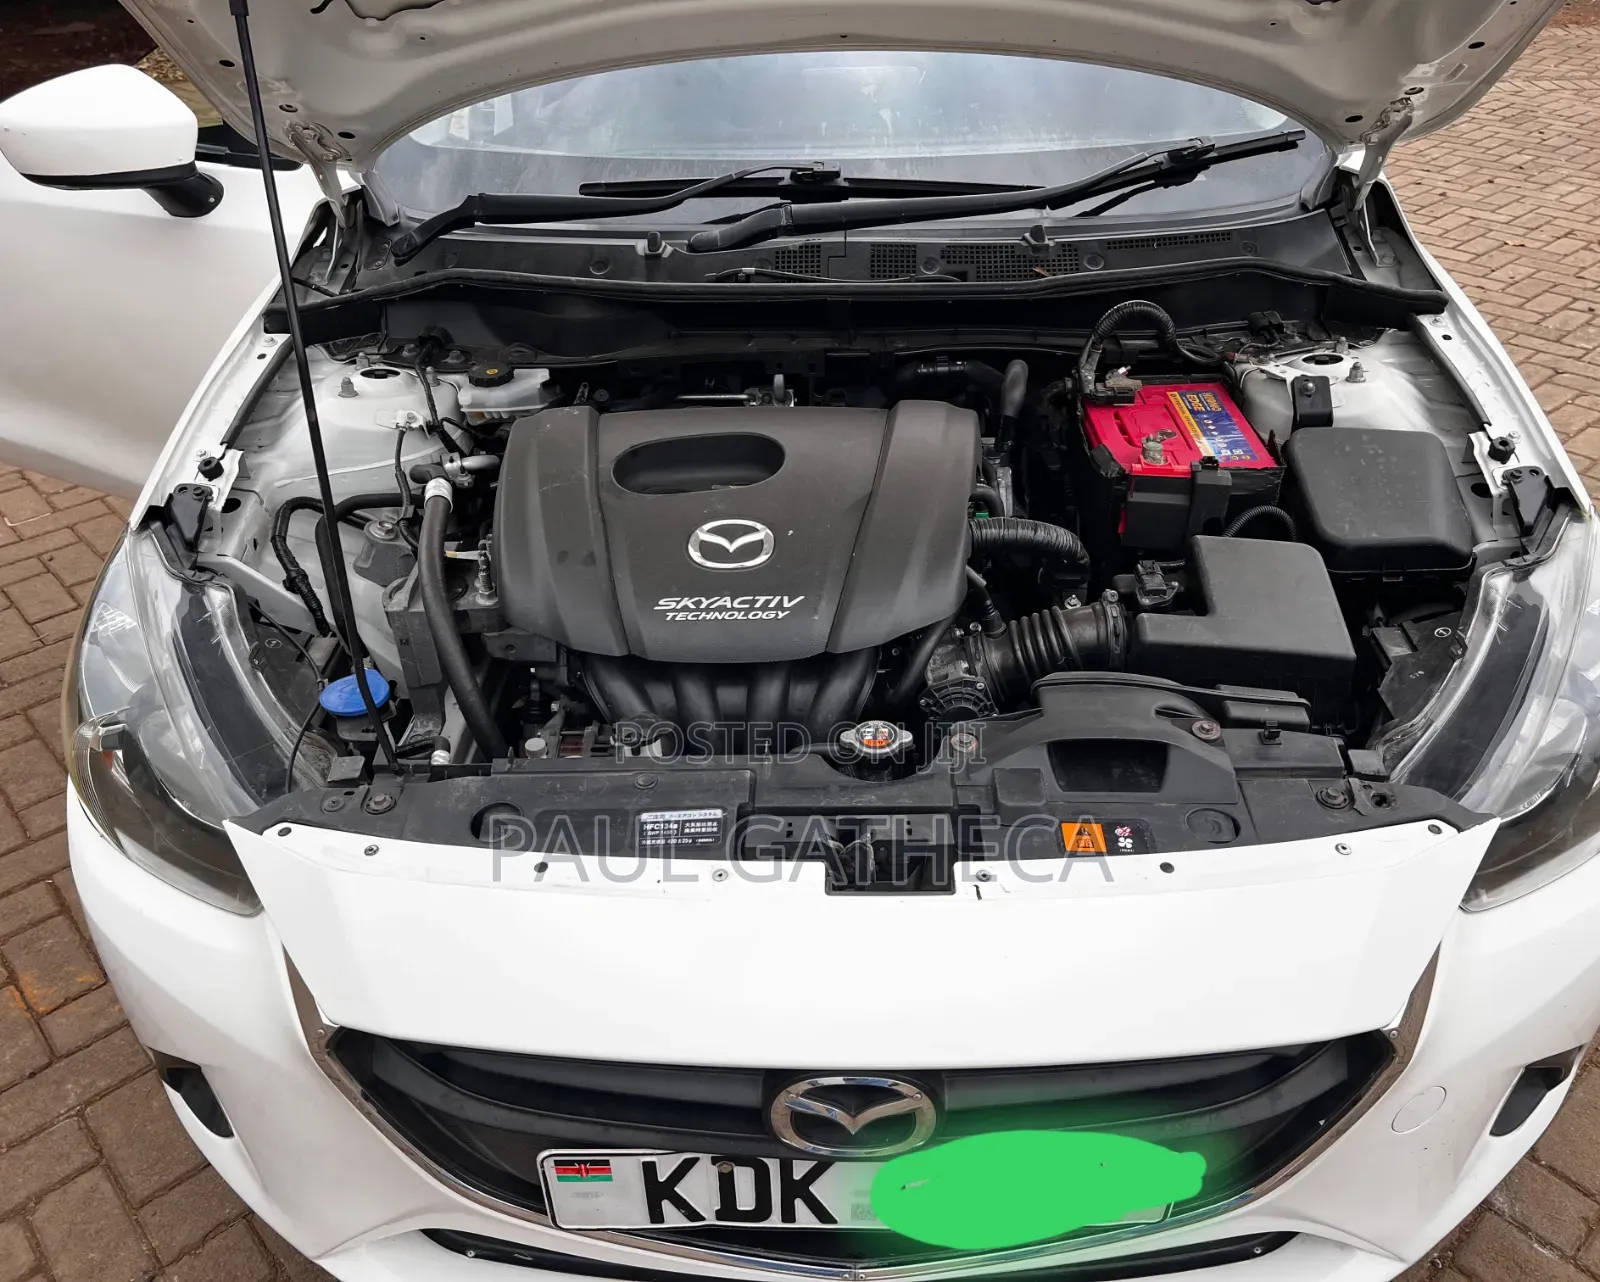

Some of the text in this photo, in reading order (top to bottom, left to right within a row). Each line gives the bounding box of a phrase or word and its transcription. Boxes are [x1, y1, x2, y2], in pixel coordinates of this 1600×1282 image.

[1186, 394, 1206, 412] EDGE
[653, 595, 805, 610] SKYACTIV
[665, 610, 791, 621] TECHNOLOGY
[643, 822, 678, 831] HFC134a
[641, 1155, 839, 1225] KDK
